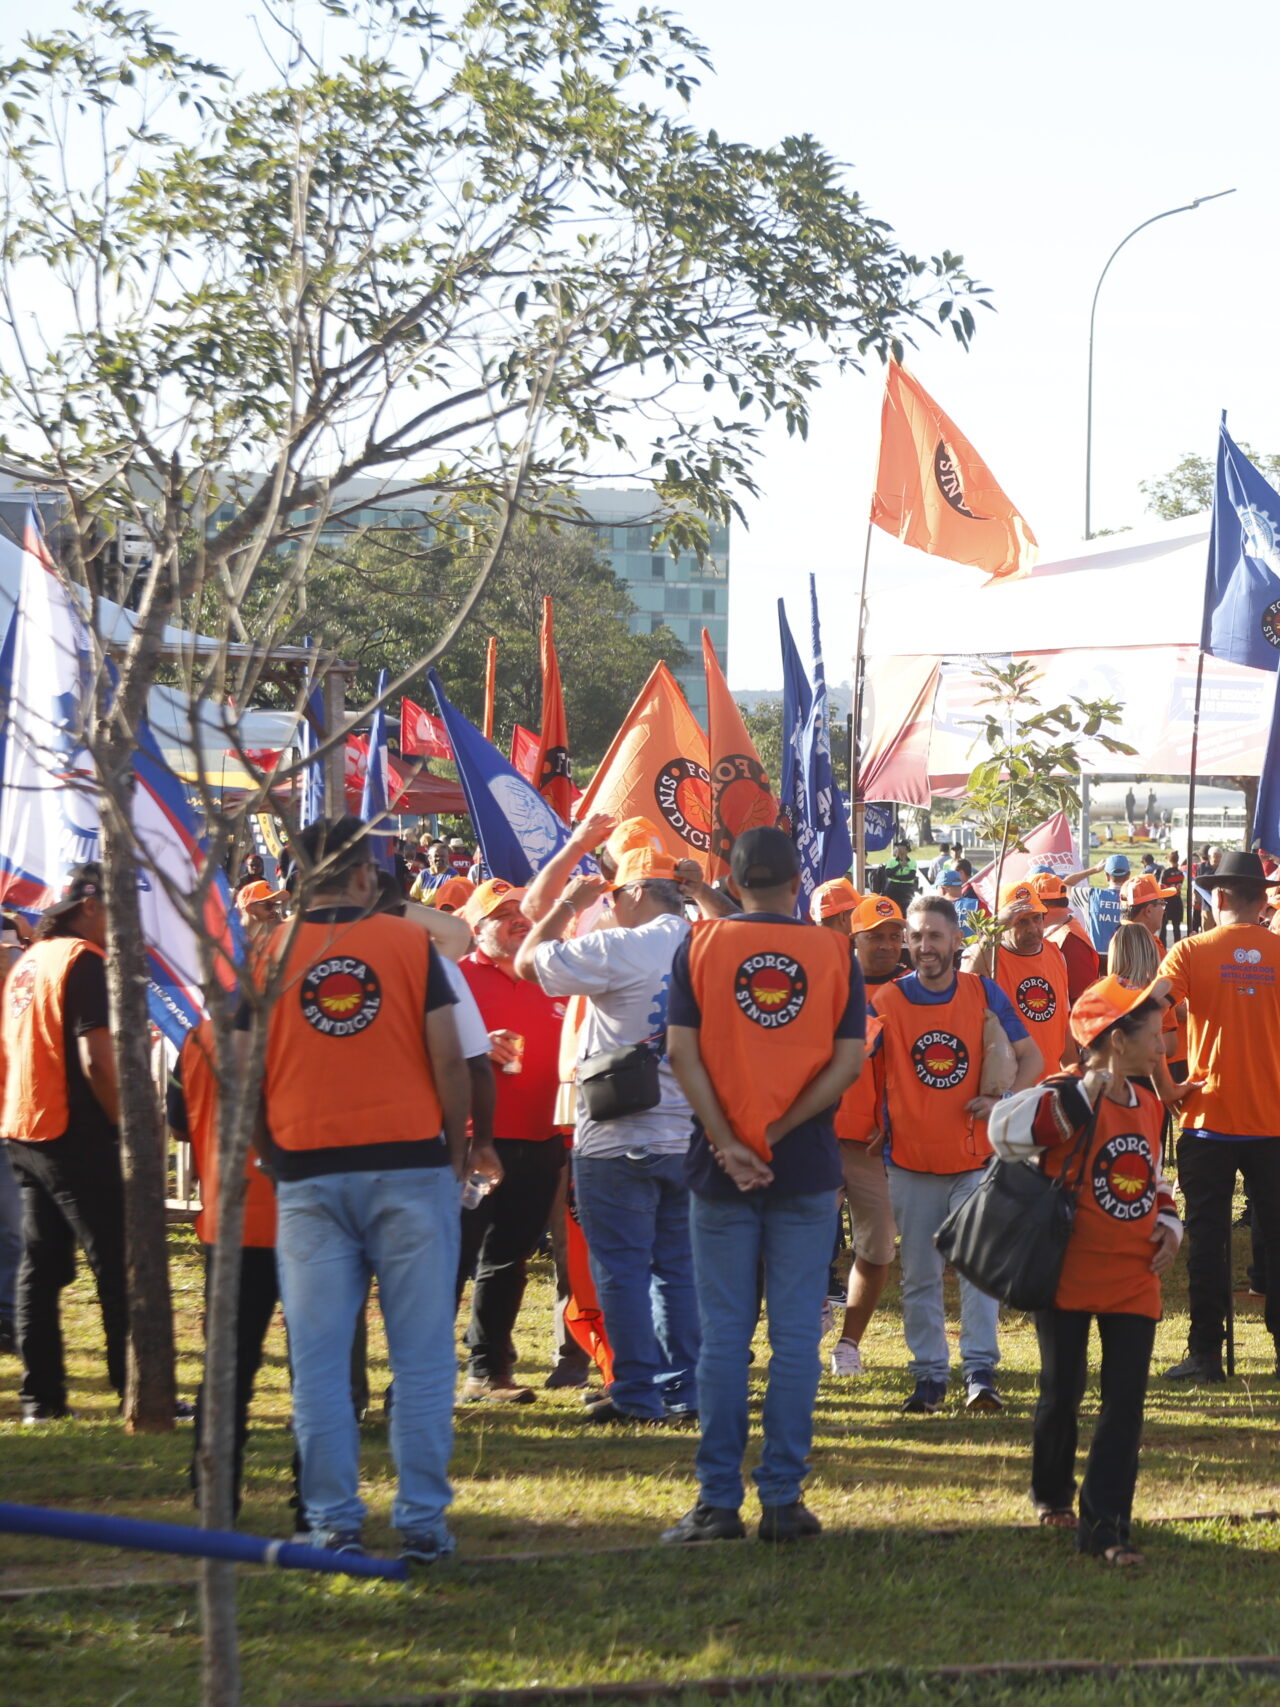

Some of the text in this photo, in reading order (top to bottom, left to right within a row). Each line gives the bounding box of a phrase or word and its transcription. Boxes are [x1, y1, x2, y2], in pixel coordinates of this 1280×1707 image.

[307, 959, 368, 985] FORÇA
[742, 954, 799, 977] FORÇA
[1020, 978, 1049, 992] FORÇA
[304, 998, 380, 1036] SINDICAL
[736, 990, 804, 1027] SINDICAL
[1019, 1002, 1056, 1021] SINDICAL
[917, 1033, 958, 1050] FORÇA
[916, 1062, 968, 1088] SINDICAL
[1094, 1176, 1156, 1219] SINDICAL
